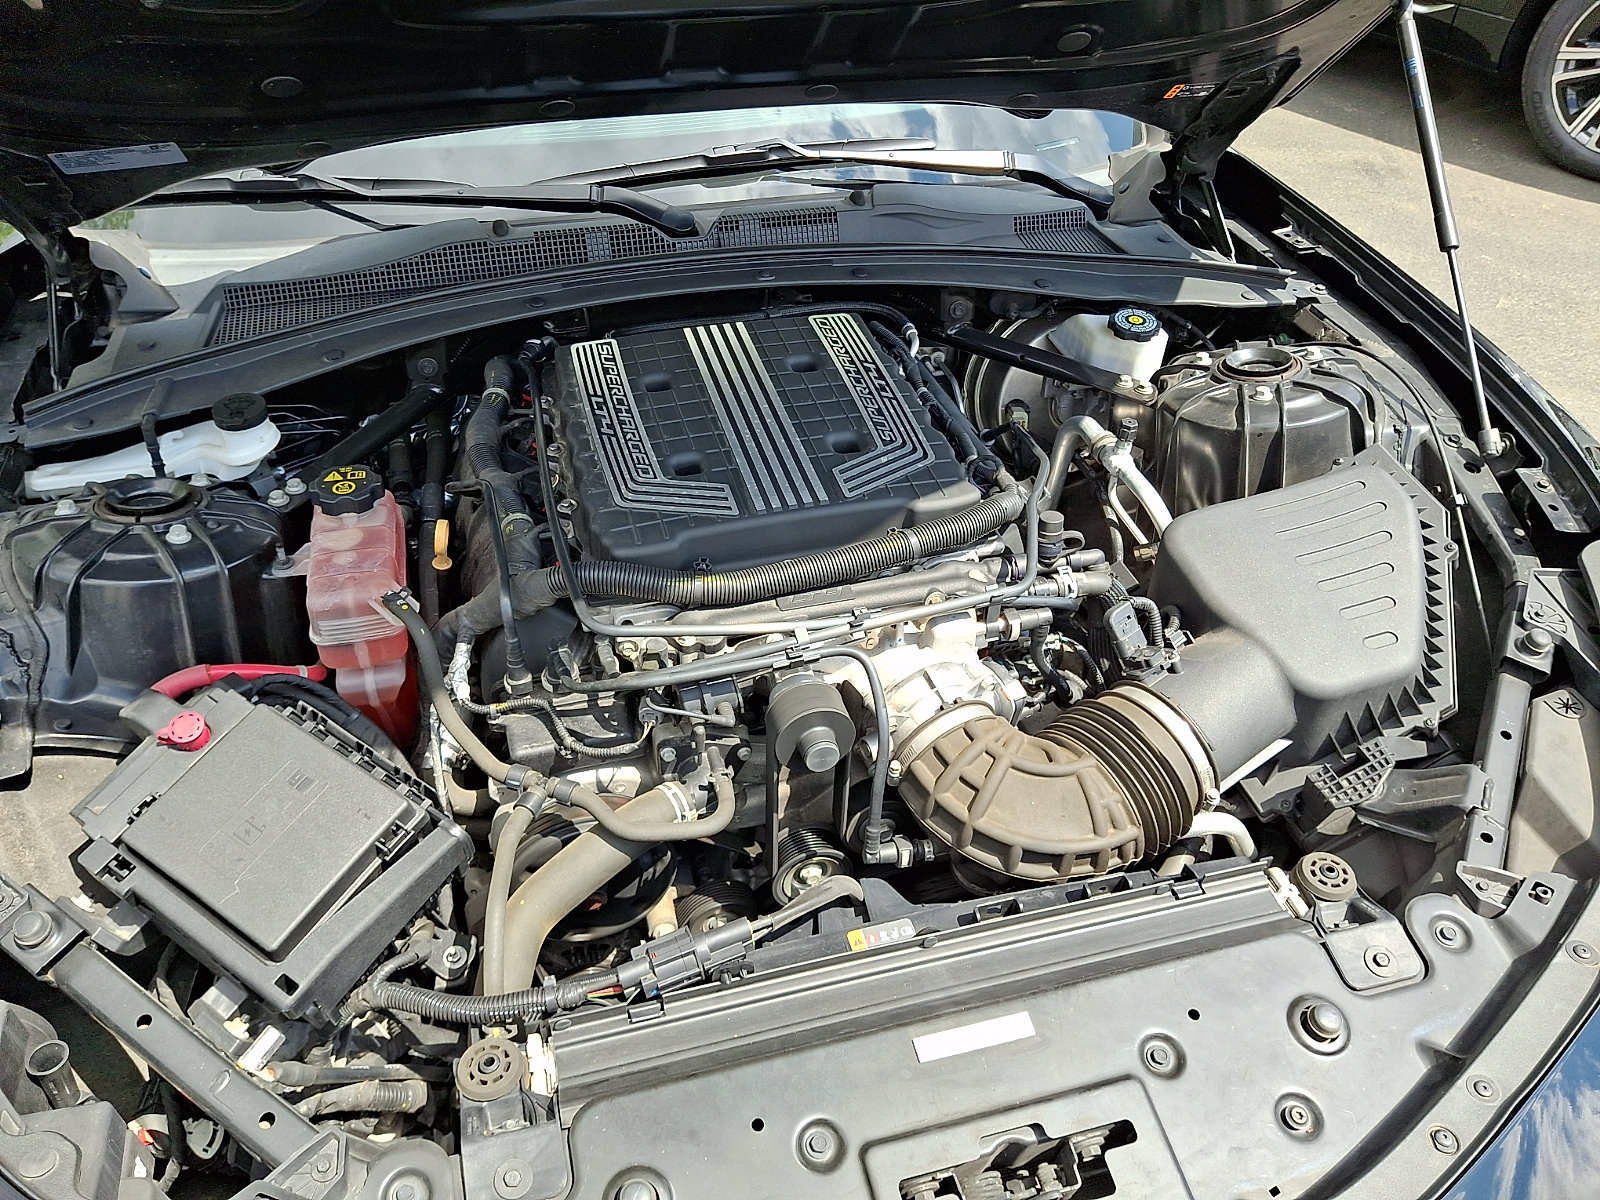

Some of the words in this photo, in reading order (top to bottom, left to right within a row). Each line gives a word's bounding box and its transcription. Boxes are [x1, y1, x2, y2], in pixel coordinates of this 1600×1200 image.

[590, 396, 615, 435] LT4
[598, 343, 655, 479] SUPERCHARGED
[816, 318, 896, 441] SUPERCHARGED
[864, 362, 894, 399] LT4
